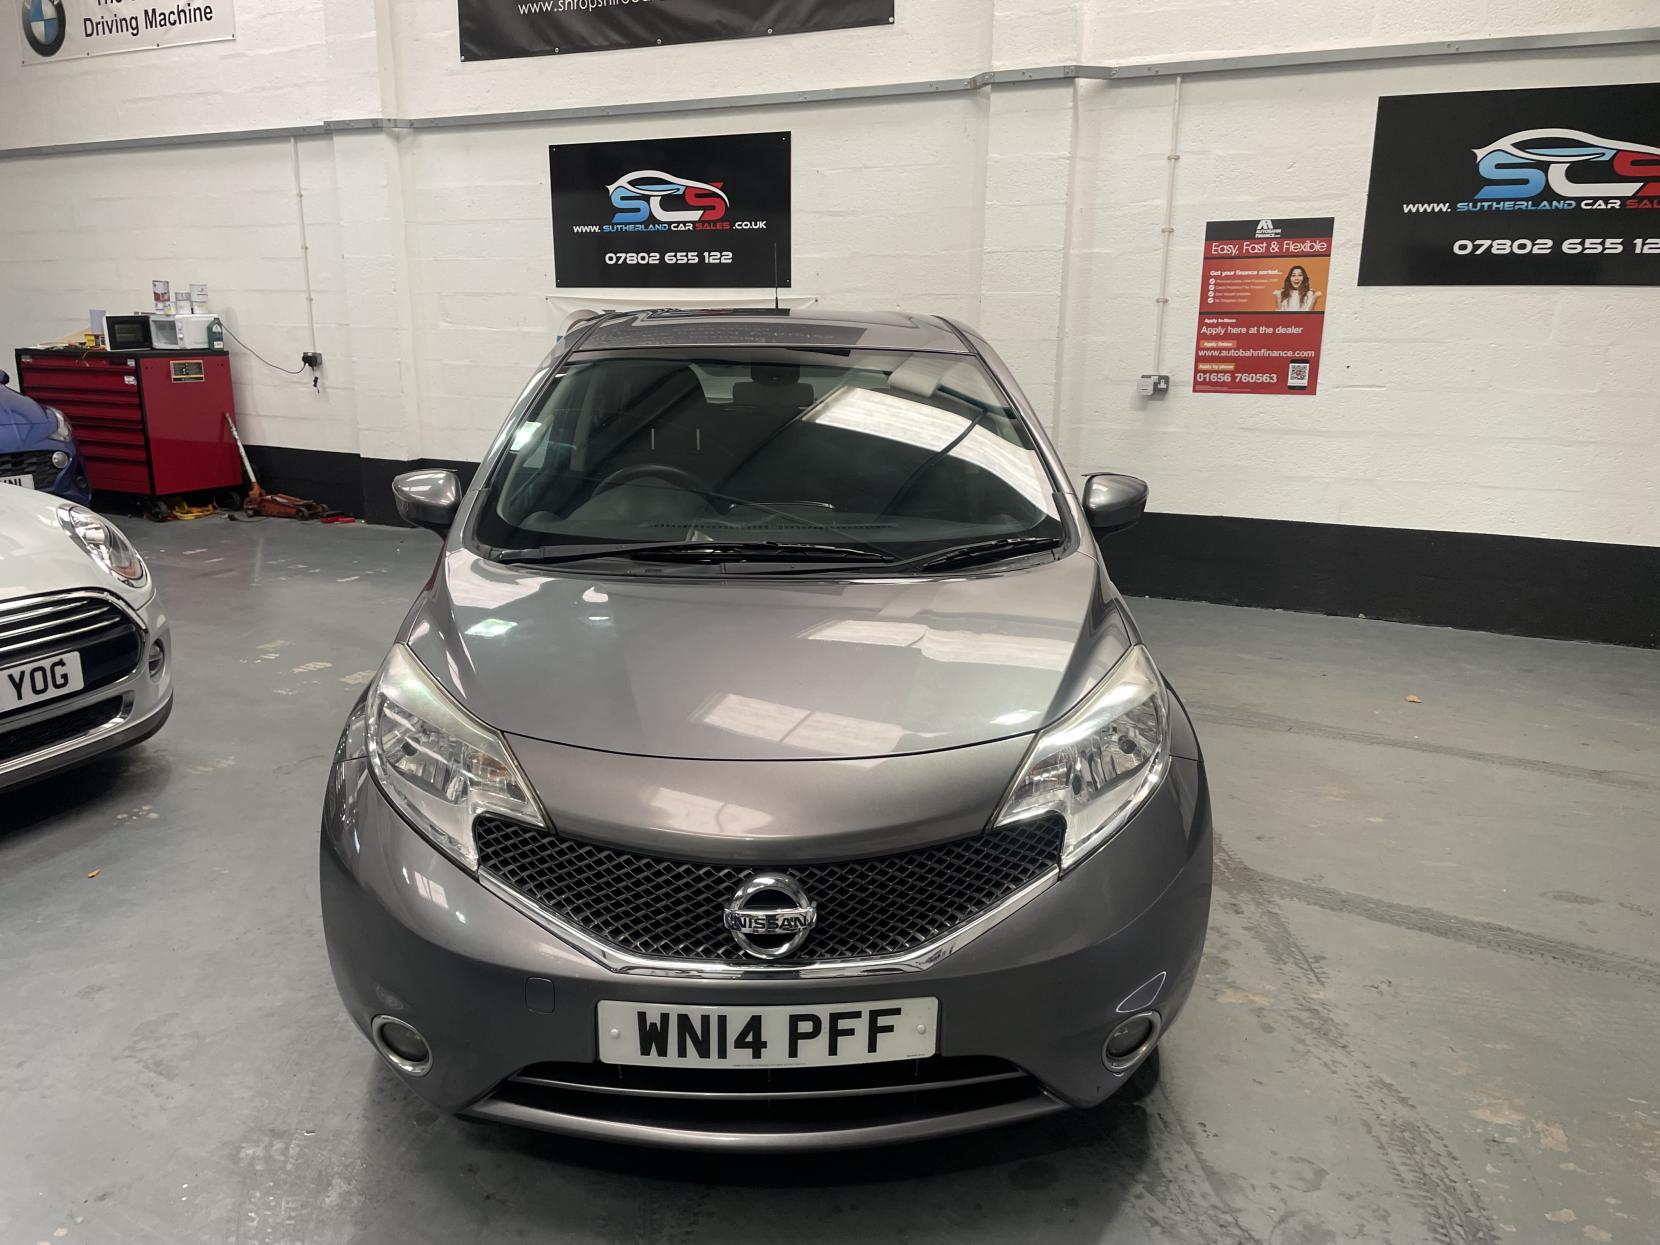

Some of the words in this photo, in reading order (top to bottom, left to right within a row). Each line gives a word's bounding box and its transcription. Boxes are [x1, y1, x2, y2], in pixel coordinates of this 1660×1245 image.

[518, 0, 651, 15] www.shrops
[83, 14, 140, 38] Driving
[143, 3, 213, 30] Machine
[1456, 199, 1576, 212] SUTHERLAND
[1580, 199, 1621, 209] CAR
[603, 222, 669, 232] SUTHERLAND
[671, 222, 694, 231] CAR
[695, 221, 731, 230] SALES
[1211, 242, 1239, 256] Easy,
[1243, 241, 1267, 253] Fast
[1270, 241, 1280, 253] &
[1283, 240, 1328, 253] Flexible
[1452, 238, 1554, 255] 07802
[1561, 238, 1624, 254] 655
[605, 251, 661, 265] 07802
[664, 251, 699, 264] 655
[704, 251, 733, 264] 122
[1200, 325, 1226, 336] Apply
[1227, 326, 1247, 335] here
[1249, 326, 1258, 334] at
[1259, 326, 1274, 334] the
[1276, 325, 1304, 335] dealer
[1198, 348, 1315, 358] www.autobahnfinance.com
[1196, 373, 1232, 382] 01656
[1235, 373, 1278, 383] 760563
[8, 657, 69, 701] YOG
[734, 915, 809, 931] NISSAN
[636, 1010, 768, 1060] WN14
[788, 1007, 902, 1059] PFF
